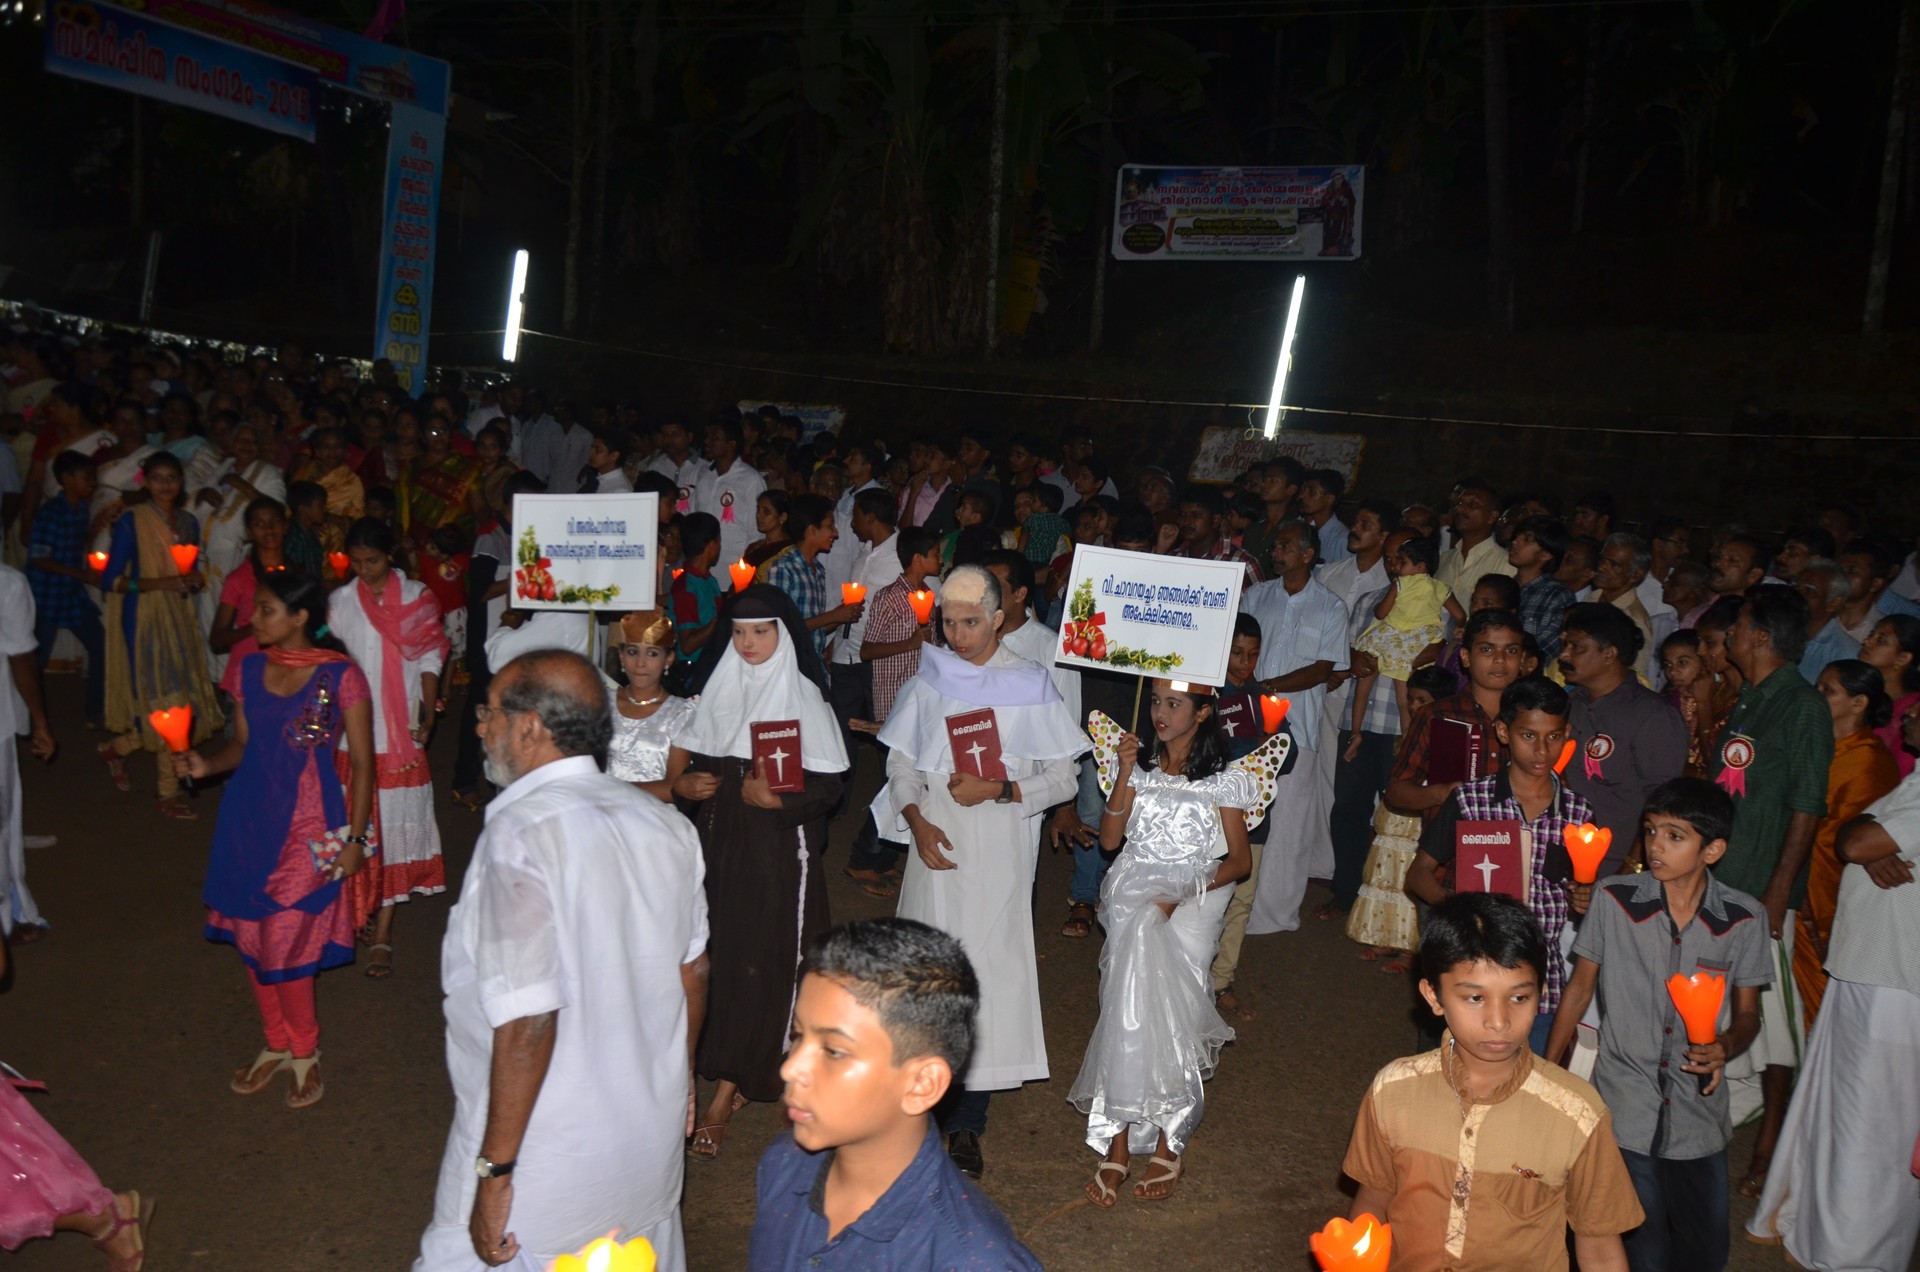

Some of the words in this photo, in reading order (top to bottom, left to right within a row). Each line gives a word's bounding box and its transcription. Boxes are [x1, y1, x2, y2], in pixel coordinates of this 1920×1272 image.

[54, 18, 168, 82] സമർപ്പിത
[1158, 184, 1209, 194] നവനാൾ
[1160, 195, 1223, 207] തിരുനാൾ
[1229, 196, 1321, 207] ആഘോഷവും
[758, 727, 798, 740] ബൈബിൾ
[953, 719, 993, 736] ബൈബിൾ
[1462, 832, 1511, 845] ബൈബിൾ
